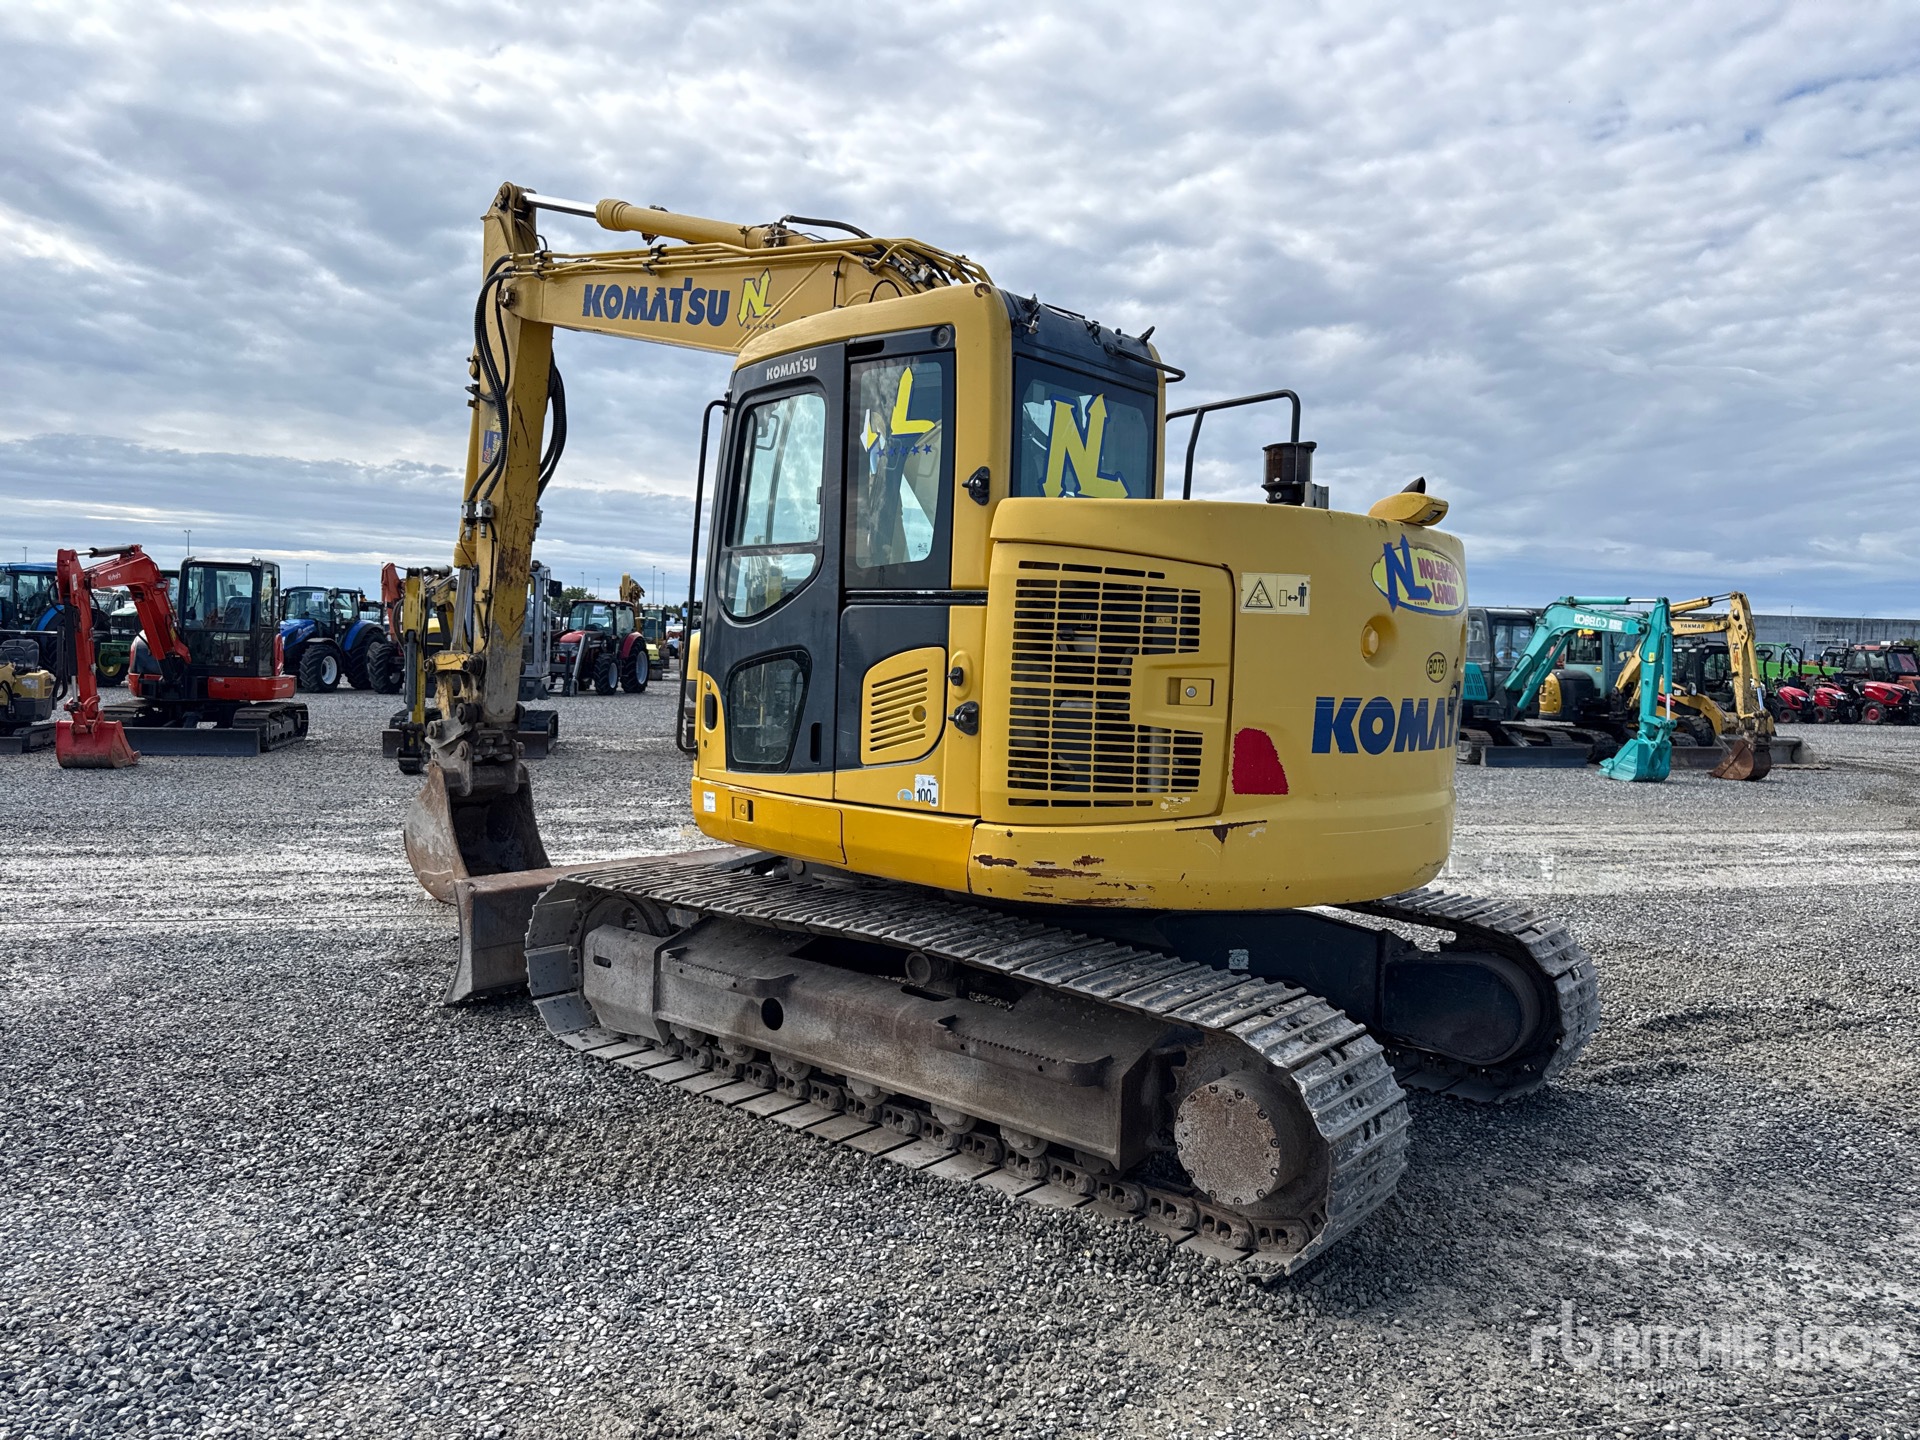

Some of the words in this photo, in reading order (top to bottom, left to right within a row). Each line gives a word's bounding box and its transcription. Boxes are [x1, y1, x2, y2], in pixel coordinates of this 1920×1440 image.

[582, 277, 731, 327] KOMATSU
[766, 356, 817, 380] KOMATSU
[1573, 613, 1608, 628] KOBELCO
[1428, 658, 1445, 675] 8073
[916, 788, 932, 803] 100
